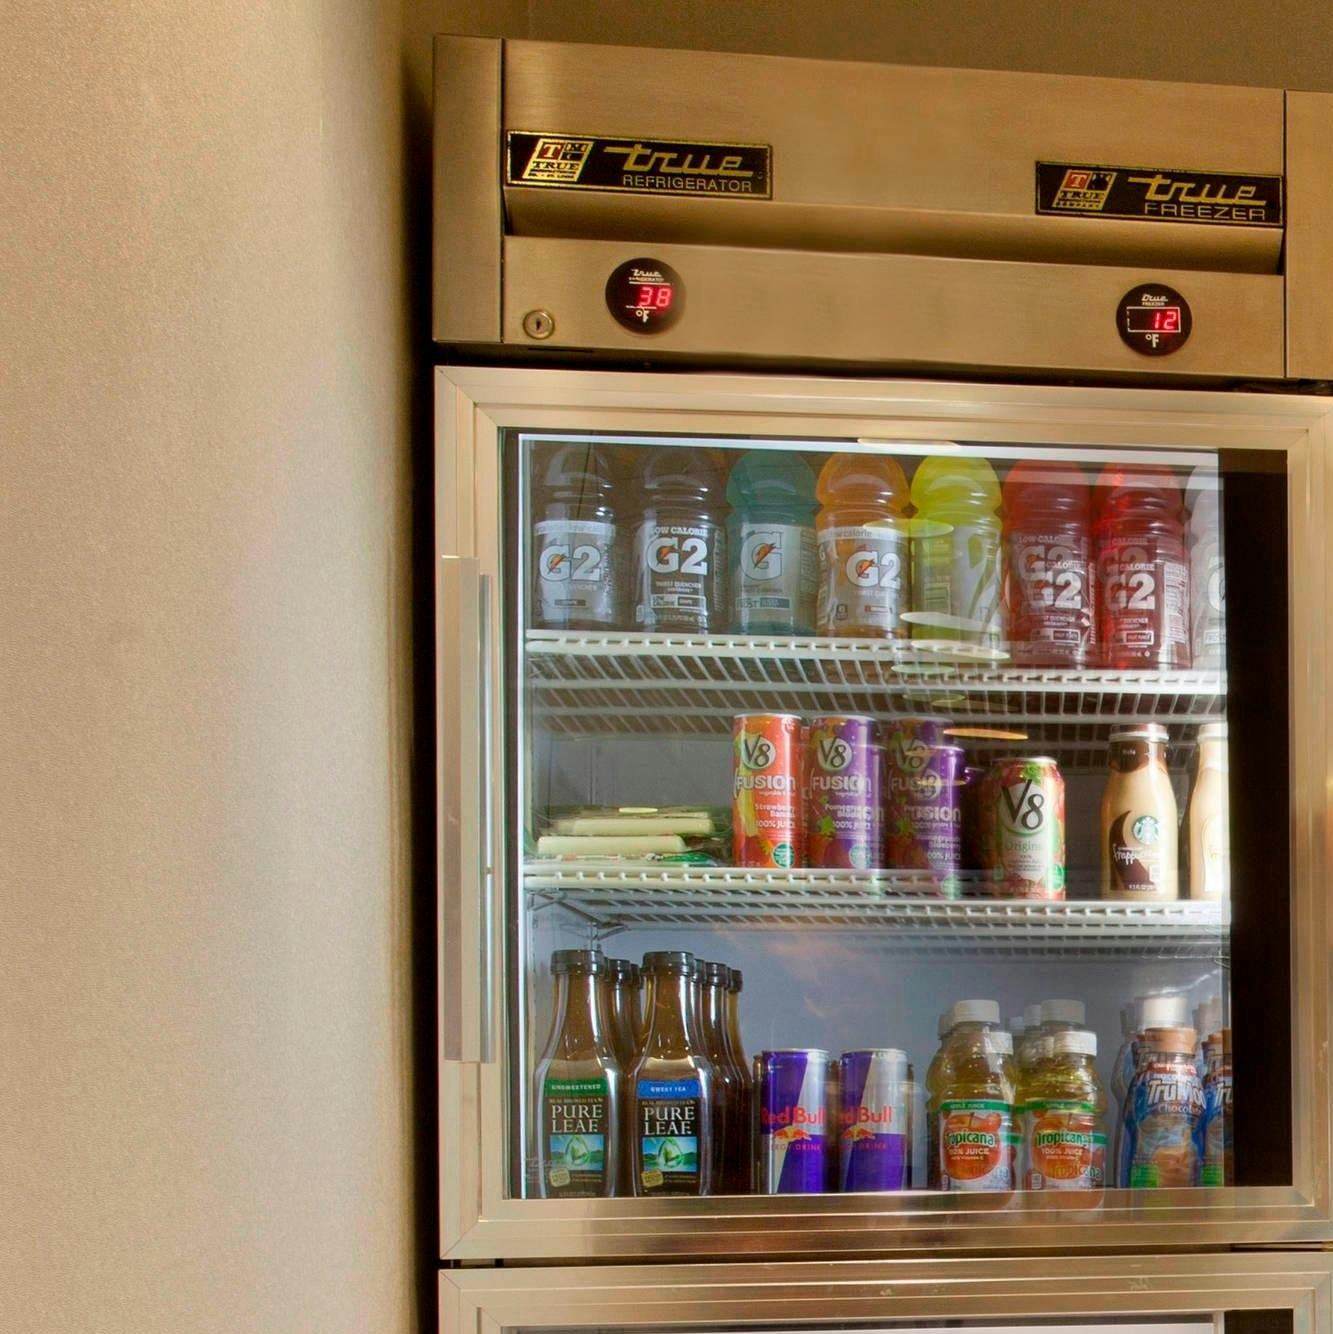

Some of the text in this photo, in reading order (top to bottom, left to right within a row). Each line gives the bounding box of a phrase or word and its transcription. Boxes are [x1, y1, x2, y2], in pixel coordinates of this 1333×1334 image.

[603, 143, 753, 177] true
[623, 174, 752, 192] REFRIGERATOR
[1128, 175, 1267, 205] true
[1145, 203, 1265, 220] FREEZER
[639, 287, 672, 307] 38
[1154, 311, 1177, 330] 12
[539, 544, 601, 582] G2
[647, 536, 708, 576] G2
[848, 551, 900, 588] G2
[744, 735, 771, 768] V8
[818, 735, 845, 768] V8
[1002, 779, 1045, 829] V8
[552, 1104, 602, 1118] PURE
[644, 1106, 695, 1120] PURE
[793, 1107, 826, 1125] Bull
[858, 1106, 892, 1123] Bull
[552, 1120, 598, 1133] LEAF
[645, 1121, 692, 1135] LEAF
